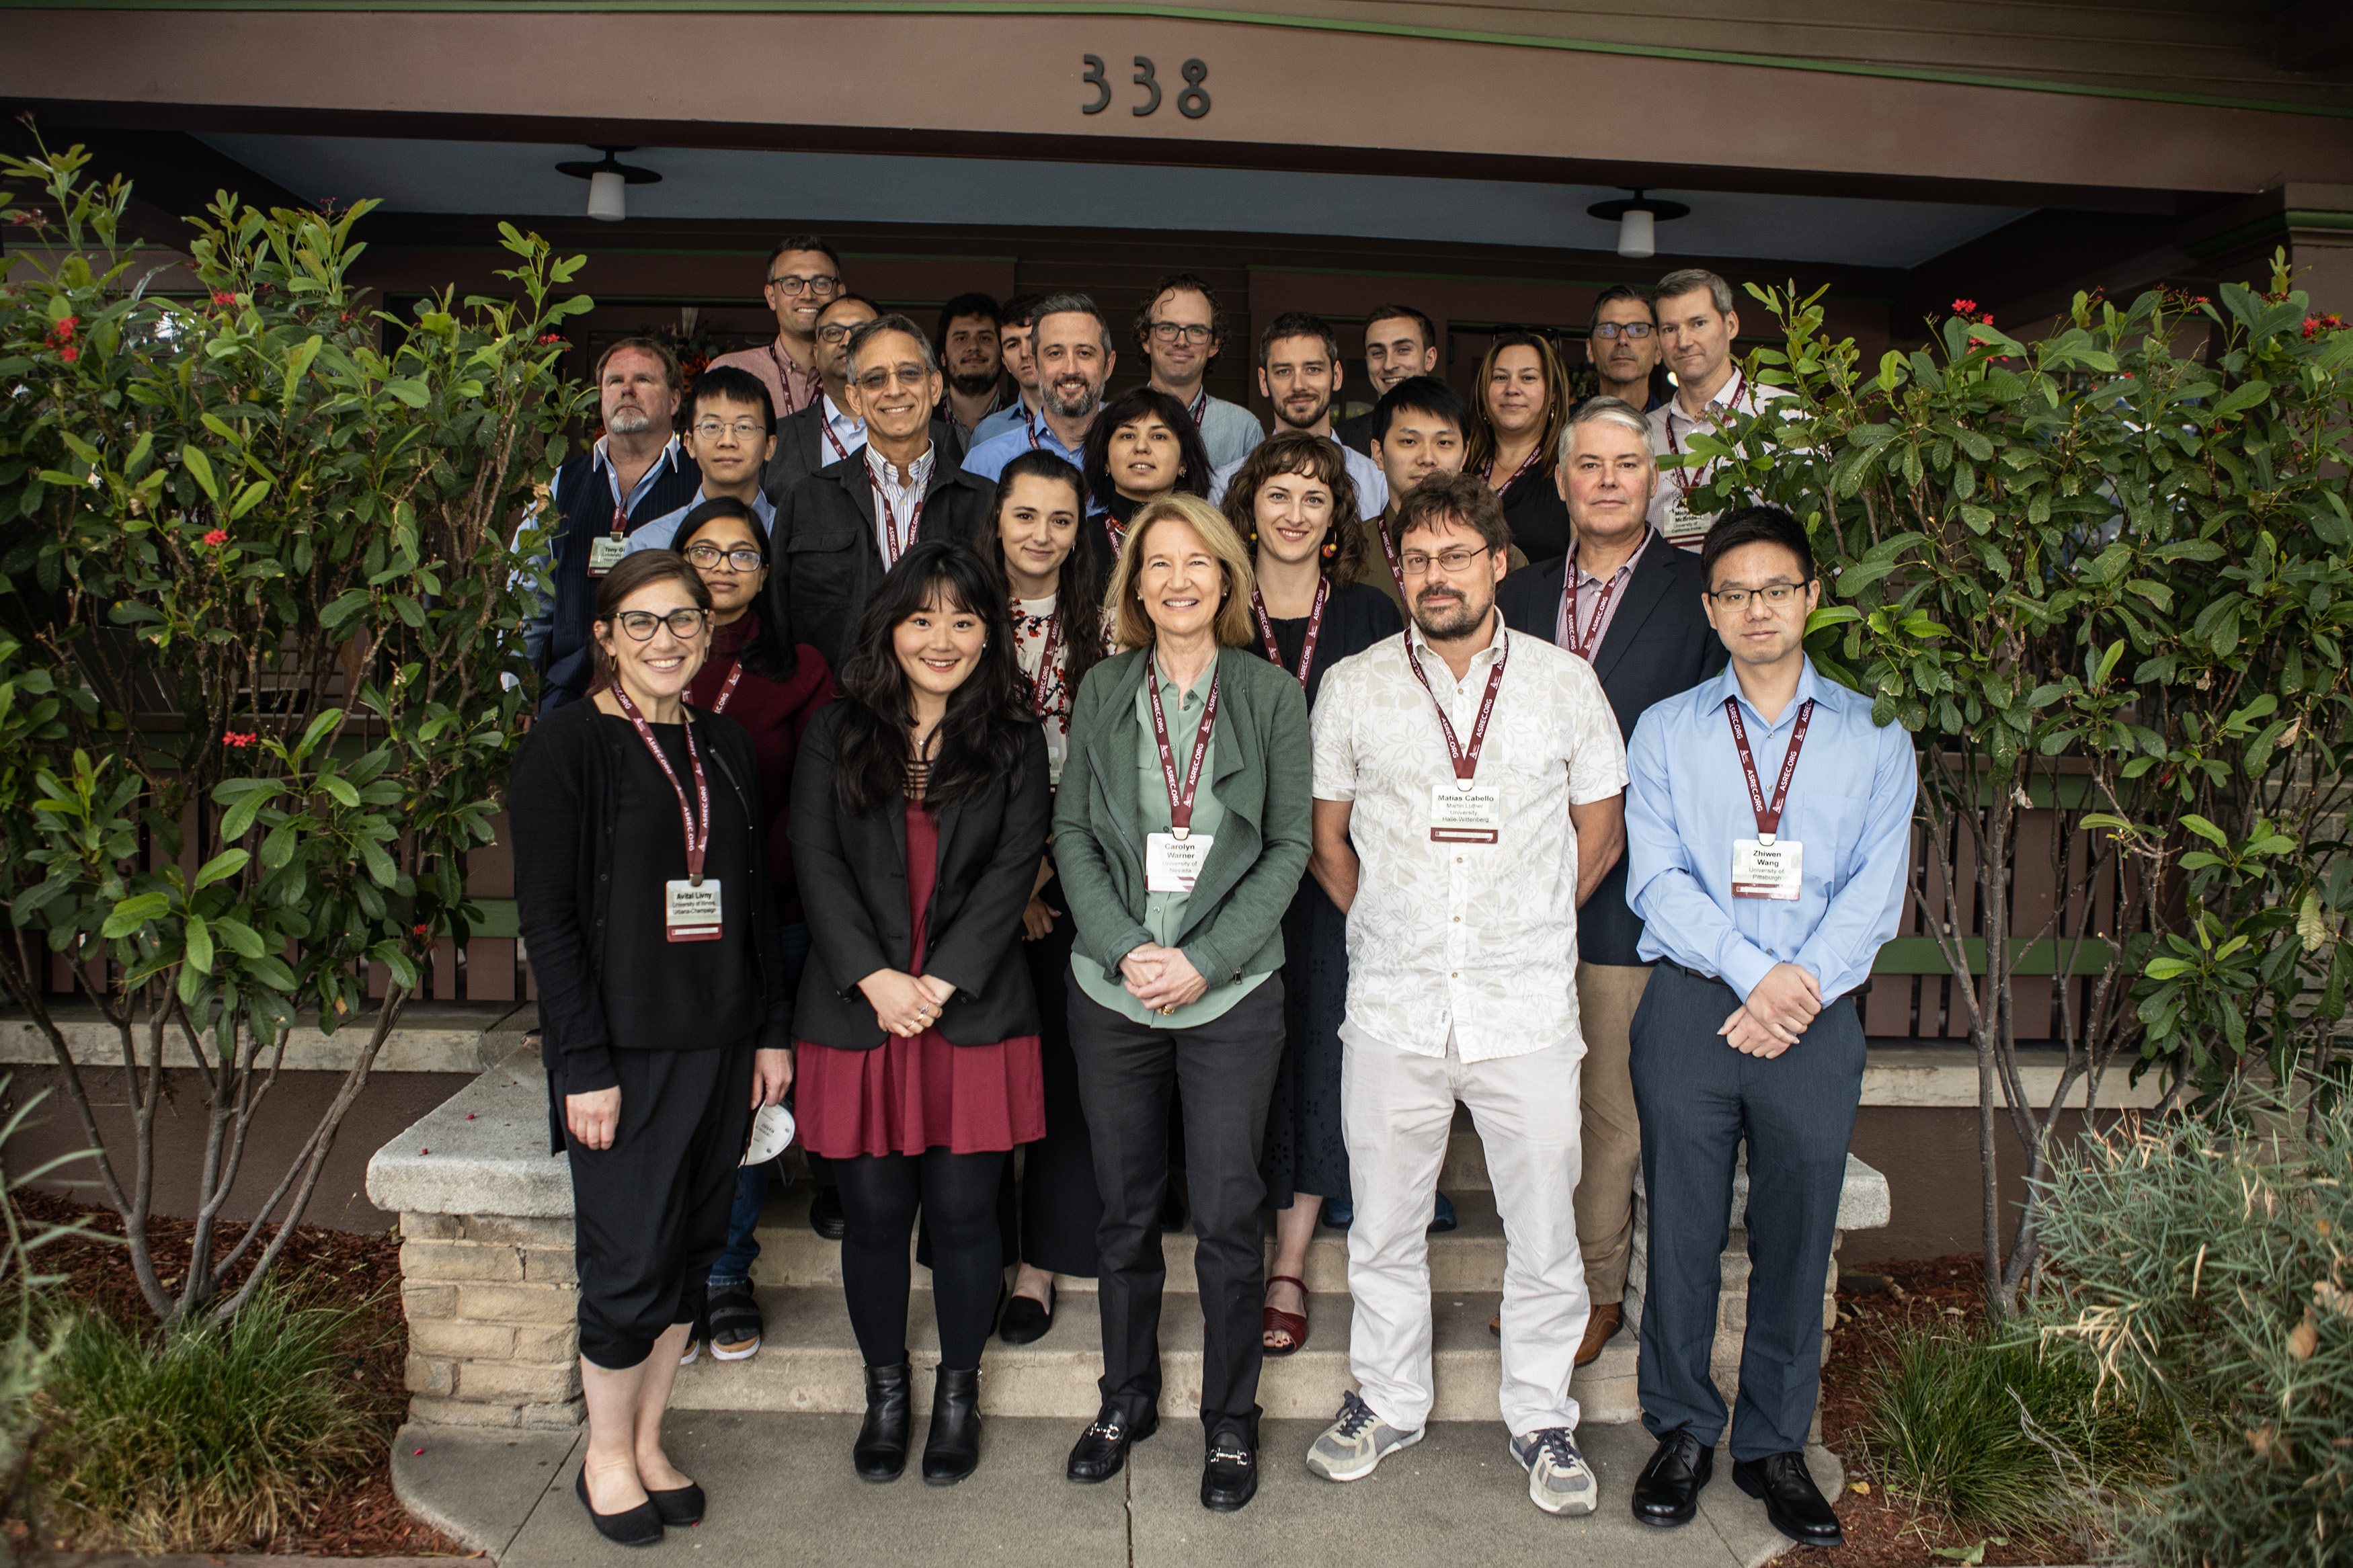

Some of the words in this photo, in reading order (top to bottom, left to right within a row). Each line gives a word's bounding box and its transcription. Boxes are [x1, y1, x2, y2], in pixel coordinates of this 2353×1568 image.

[1082, 53, 1211, 118] 338
[889, 526, 898, 563] ASREC.ORG
[910, 511, 920, 545] ASREC.ORG
[1257, 606, 1271, 638] ASREC.ORG
[1313, 589, 1324, 621] ASREC.ORG
[1591, 596, 1608, 632] ASREC.ORG
[1568, 614, 1576, 651] ASREC.ORG
[1300, 645, 1312, 680] ASREC.ORG
[1037, 665, 1049, 702] ASREC.ORG
[1152, 694, 1164, 734] ASREC.ORG
[1476, 698, 1492, 738] ASREC.ORG
[1728, 703, 1743, 739] ASREC.ORG
[1441, 716, 1459, 759] ASREC.ORG
[1189, 743, 1204, 786] ASREC.ORG
[1780, 751, 1797, 791] ASREC.ORG
[1166, 765, 1179, 807] ASREC.ORG
[1747, 770, 1763, 813] ASREC.ORG
[700, 786, 709, 828] ASREC.ORG
[683, 807, 694, 852] ASREC.ORG
[1164, 843, 1195, 852] Carolyn
[1757, 859, 1779, 868] Wang
